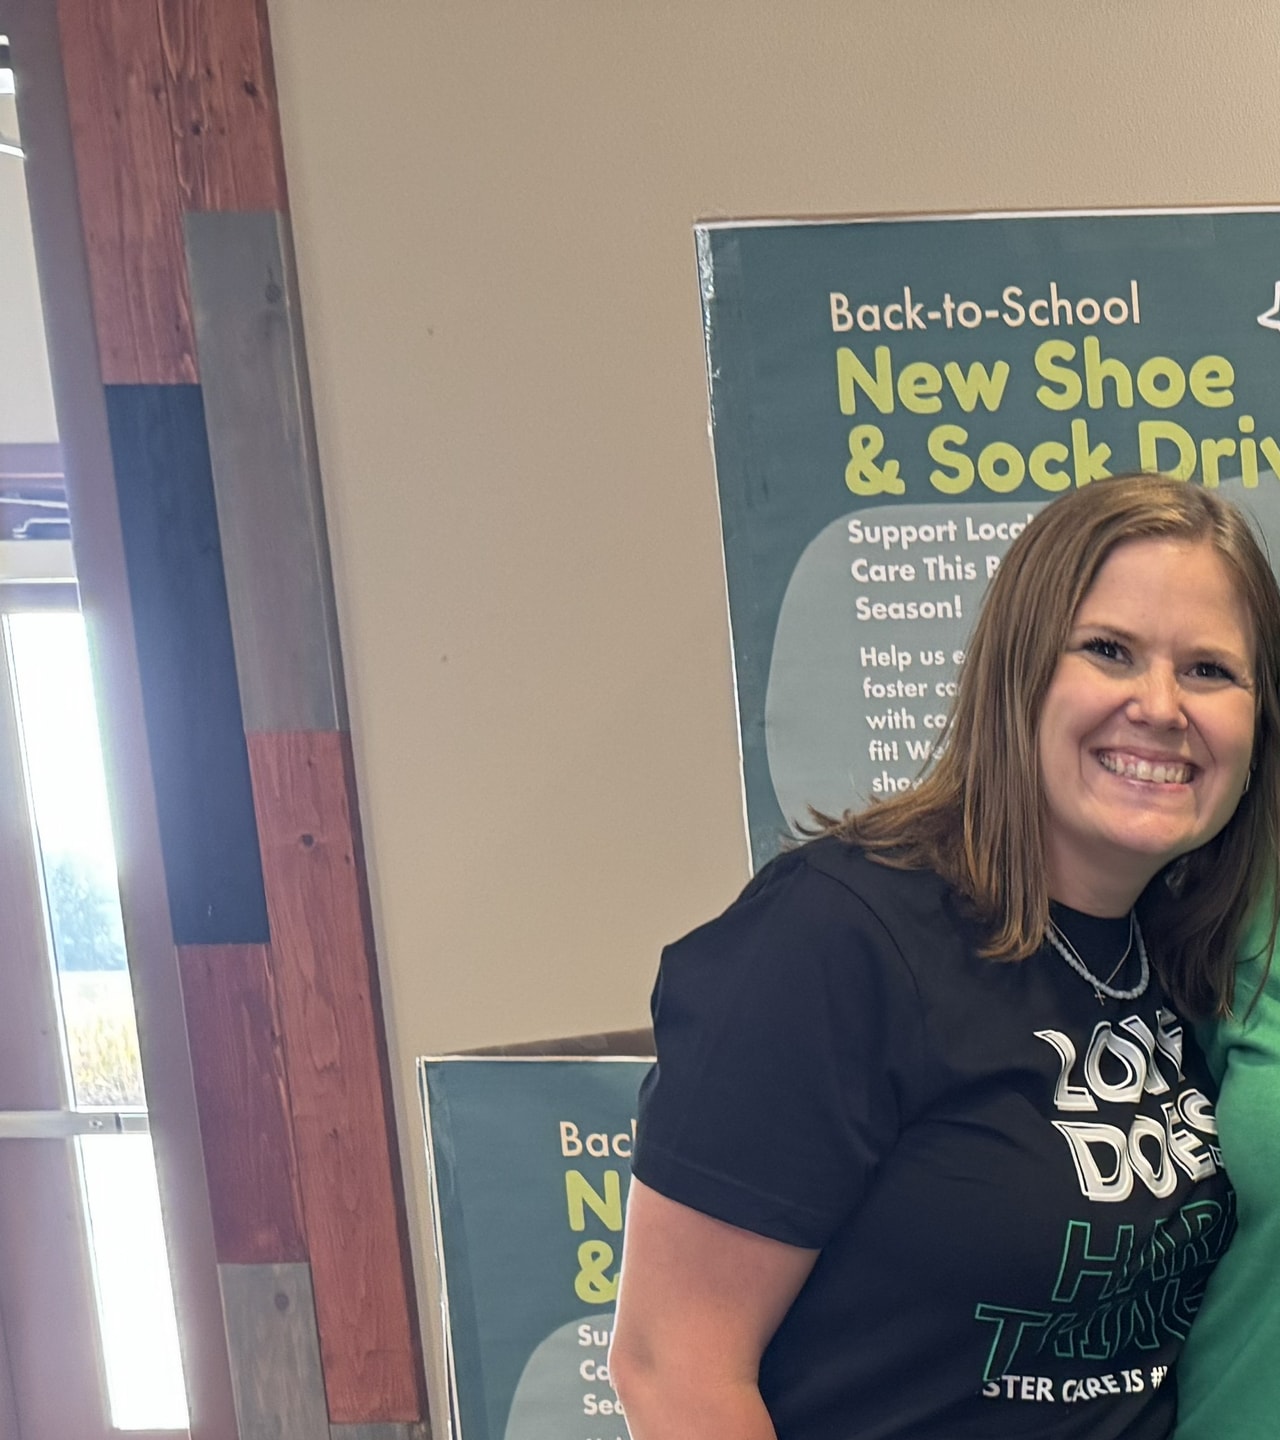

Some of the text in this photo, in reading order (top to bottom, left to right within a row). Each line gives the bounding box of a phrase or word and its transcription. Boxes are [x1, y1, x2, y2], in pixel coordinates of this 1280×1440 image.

[830, 281, 1141, 332] Back-to-School
[836, 336, 1236, 414] New Shoe
[845, 425, 905, 495] &
[928, 419, 1112, 494] Sock
[848, 519, 957, 550] Support
[851, 558, 915, 583] Care
[923, 555, 976, 582] This
[856, 595, 962, 621] Season!
[860, 644, 912, 672] Help
[920, 649, 945, 665] us
[863, 677, 928, 698] foster
[866, 708, 915, 730] with
[869, 739, 899, 761] fit!
[575, 1240, 621, 1304] &
[983, 1374, 1054, 1402] STER
[1062, 1373, 1120, 1402] CARE
[1121, 1369, 1144, 1393] IS
